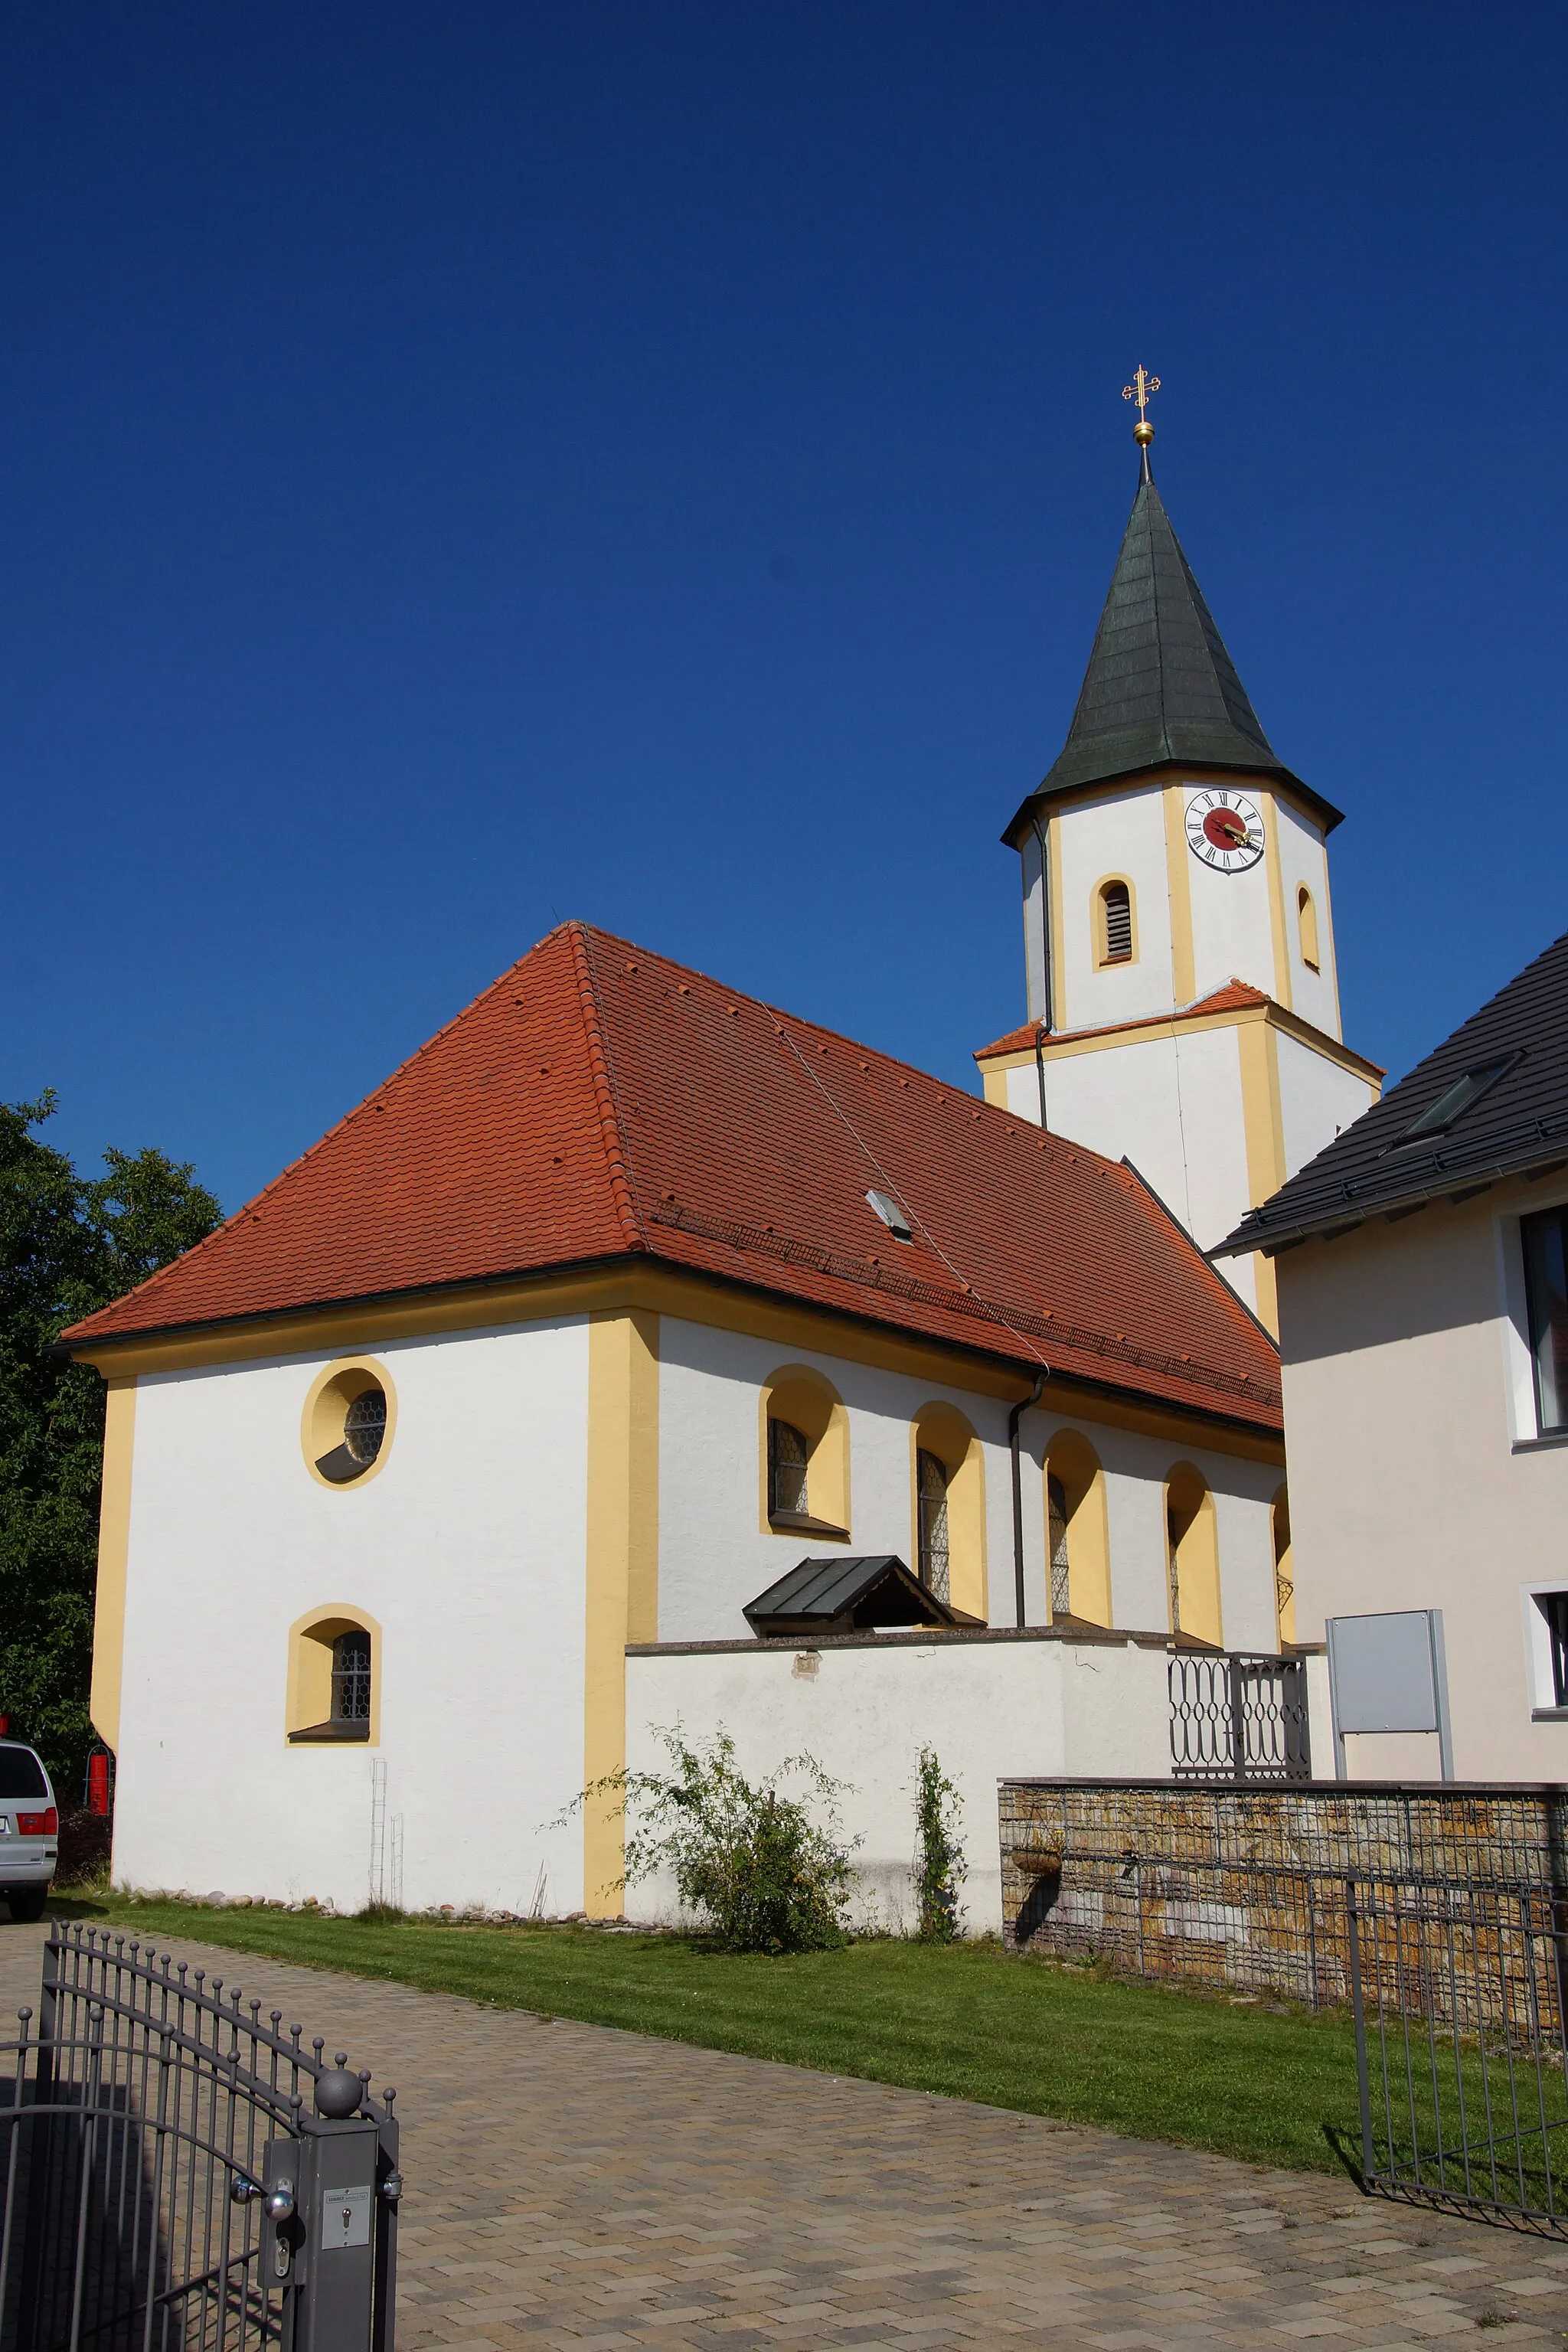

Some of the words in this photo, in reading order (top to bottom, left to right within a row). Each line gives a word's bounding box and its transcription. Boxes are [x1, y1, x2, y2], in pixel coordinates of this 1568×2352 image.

[1202, 794, 1215, 808] XI
[1219, 792, 1228, 806] XII
[1235, 799, 1243, 810] I
[1191, 805, 1205, 817] X
[1244, 812, 1257, 822] II
[1187, 822, 1201, 831] IX
[1248, 828, 1263, 837] III
[1191, 835, 1206, 849] VIII
[1204, 846, 1217, 862] VII
[1223, 852, 1230, 867] VI
[1237, 851, 1249, 864] V
